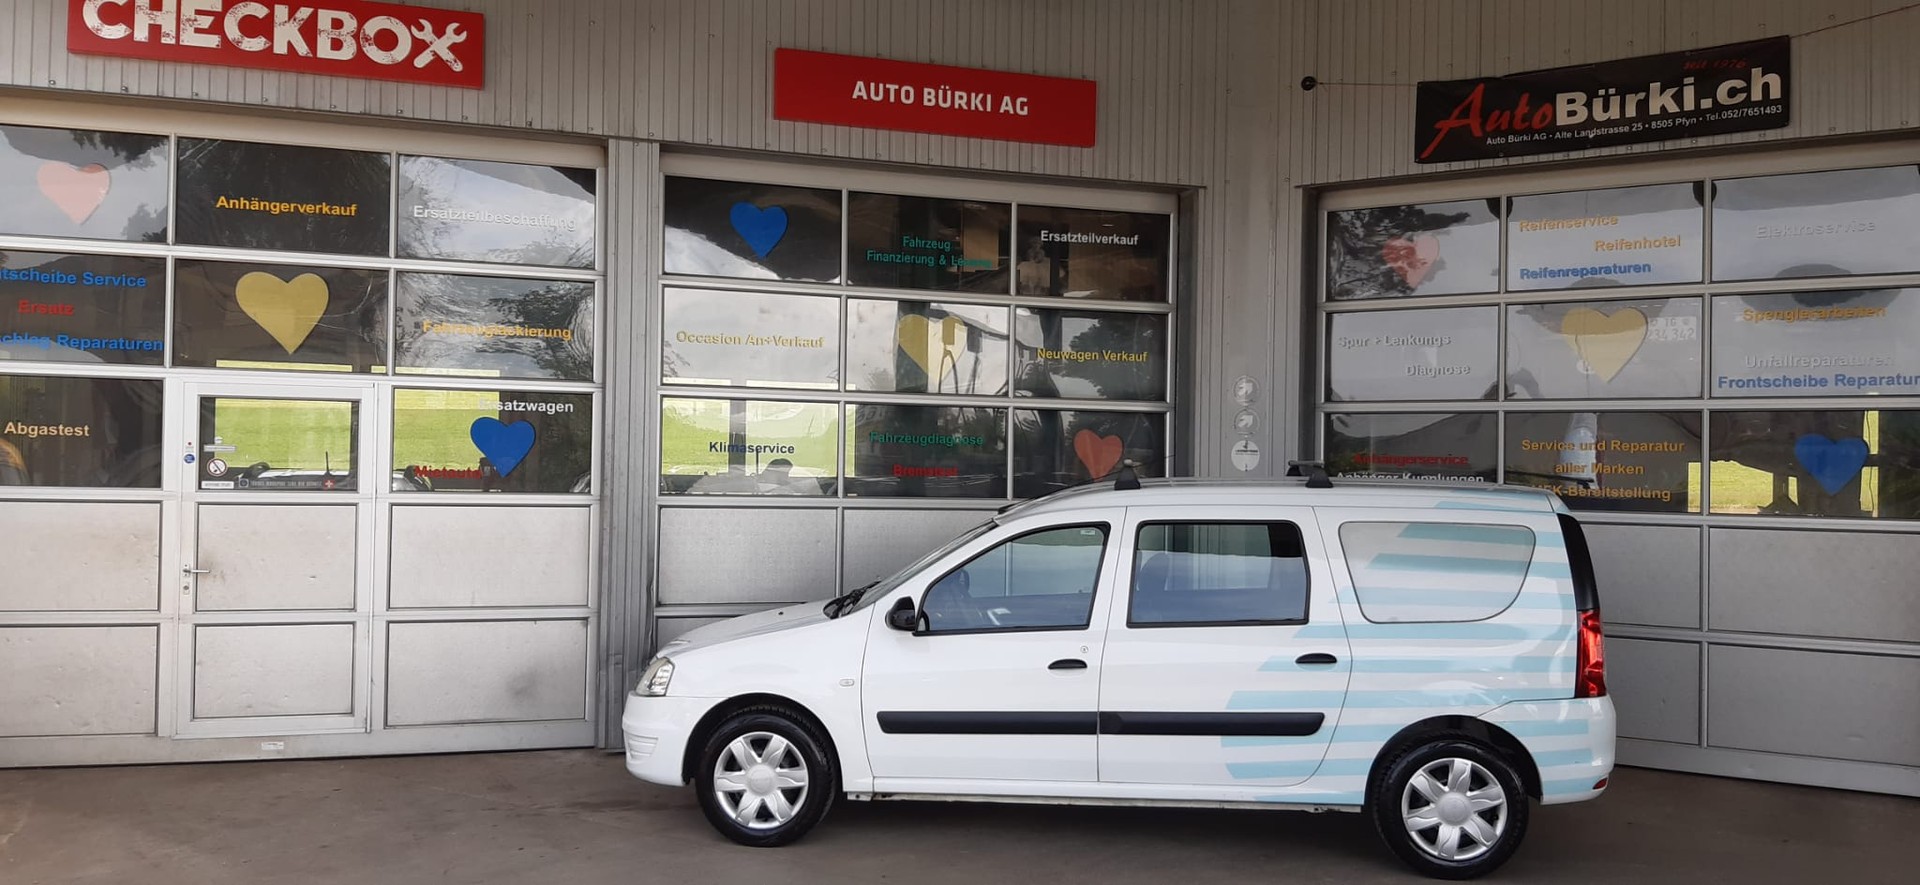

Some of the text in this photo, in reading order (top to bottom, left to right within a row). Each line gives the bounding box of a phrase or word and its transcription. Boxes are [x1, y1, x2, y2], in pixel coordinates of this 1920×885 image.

[82, 0, 467, 72] CHECKBOX
[852, 80, 1028, 116] AUTO BÜRKI AG
[1486, 136, 1506, 145] Auto
[1508, 134, 1531, 143] Bürki
[1532, 132, 1547, 141] AG
[1555, 129, 1572, 139] Alte
[1575, 124, 1630, 138] Landstrasse
[1632, 122, 1643, 132] 25
[1651, 119, 1673, 129] 8505
[1676, 116, 1697, 128] Pfyn
[216, 195, 357, 216] Anhängerverkauf
[413, 205, 577, 231] Ersatzteilbeschaffung
[1519, 215, 1619, 232] Reifenservice
[1040, 230, 1139, 245] Ersatzteilverkauf
[1756, 219, 1876, 239] Elektroservice
[902, 236, 952, 252] Fahrzeug
[1595, 235, 1681, 251] Reifenhotel
[866, 250, 935, 267] Finanzierung
[938, 254, 947, 265] &
[83, 271, 147, 288] Service
[1519, 262, 1652, 280] Reifenreparaturen
[18, 299, 75, 316] Ersatz
[1743, 306, 1888, 323] Spenglerarbeiten
[422, 320, 573, 340] Fahrzeuglackierung
[676, 330, 741, 345] Occasion
[0, 332, 165, 351] chlag Reparaturen
[1338, 336, 1370, 349] Spur
[1385, 334, 1452, 347] Lenkungs
[1036, 347, 1148, 362] Neuwagen Verkauf
[1406, 364, 1471, 378] Diagnose
[1718, 375, 1829, 389] Frontscheibe
[478, 398, 574, 415] Esatzwagen
[4, 421, 90, 438] Abgastest
[709, 441, 795, 454] Klimaservice
[869, 431, 984, 447] Fahrzeugdiagnose
[1521, 439, 1685, 453] Service und Reparatur
[1555, 462, 1644, 475] aller Marken
